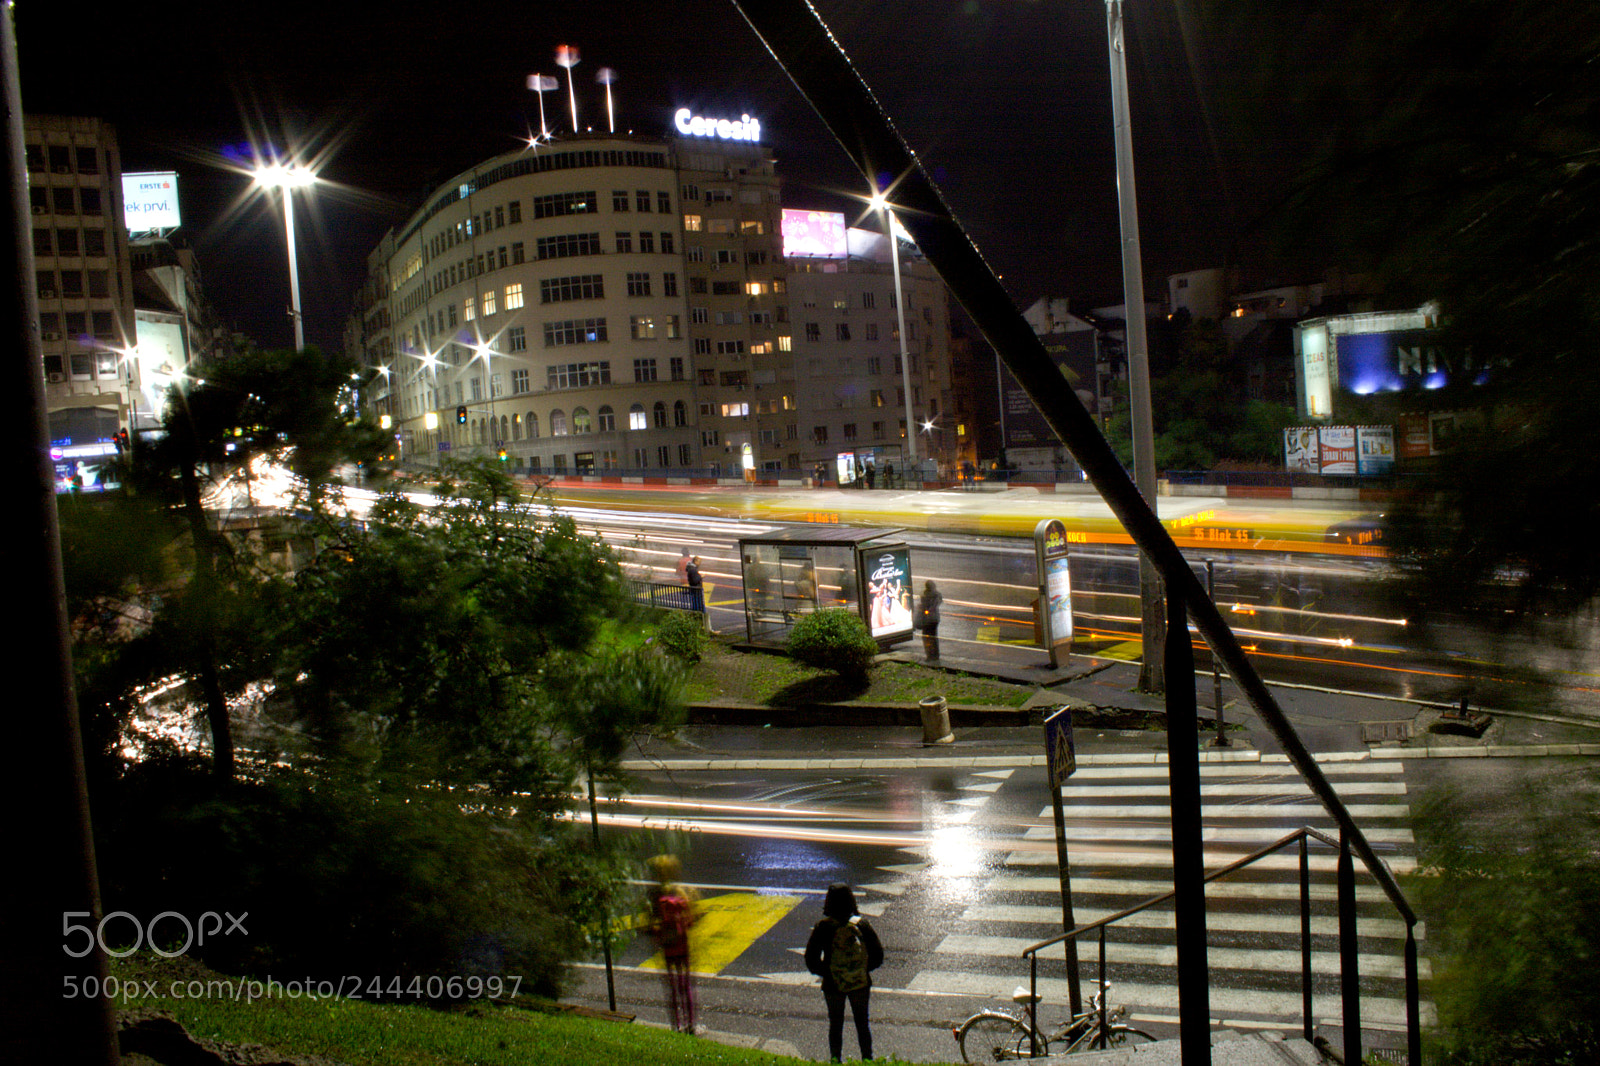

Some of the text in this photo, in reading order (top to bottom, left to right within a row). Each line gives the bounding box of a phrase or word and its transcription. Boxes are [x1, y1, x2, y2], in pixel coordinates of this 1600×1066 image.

[674, 107, 761, 142] Ceresit
[140, 182, 161, 190] ERSTE
[143, 200, 171, 213] prvi.
[1209, 528, 1232, 542] Blok
[1236, 529, 1249, 544] 45
